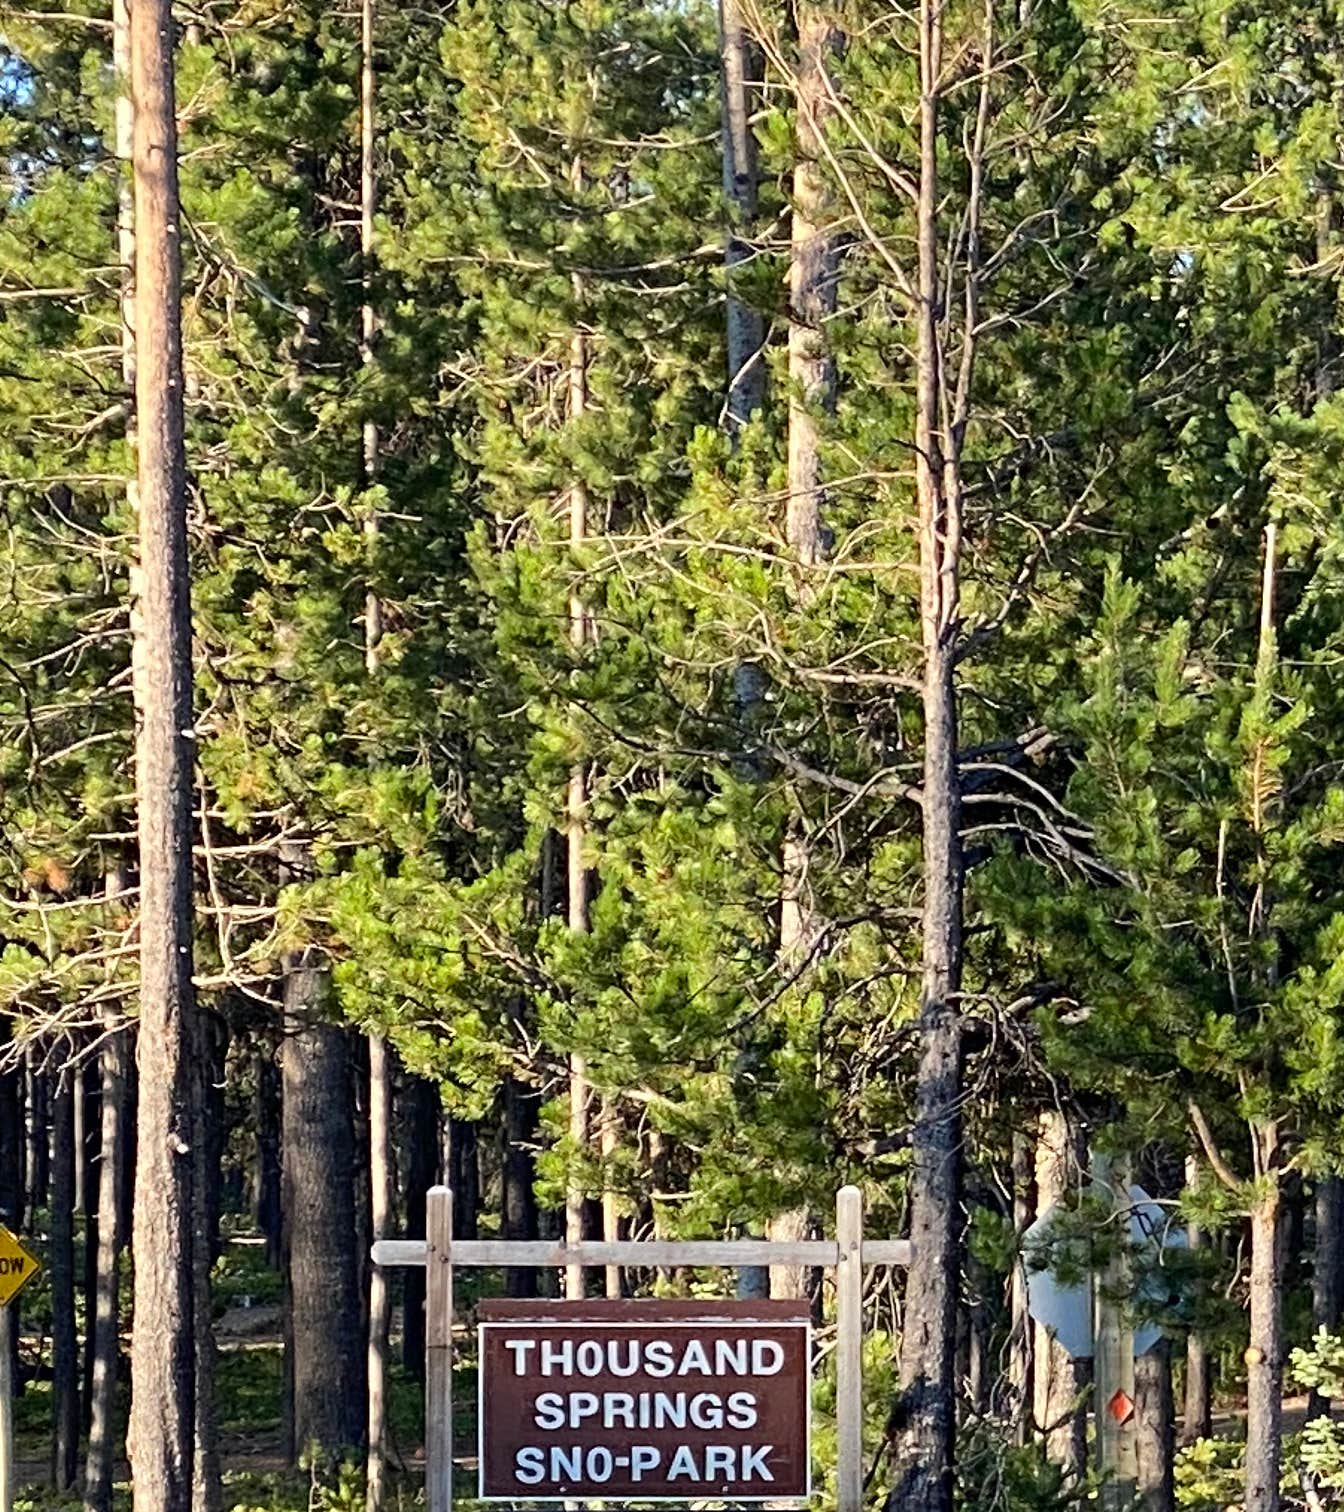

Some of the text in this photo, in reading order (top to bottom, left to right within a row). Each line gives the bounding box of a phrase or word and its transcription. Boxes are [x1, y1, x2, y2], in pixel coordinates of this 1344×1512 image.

[505, 1340, 785, 1377] THOUSAND
[534, 1392, 758, 1429] SPRINGS
[515, 1446, 775, 1484] SNO-PARK
